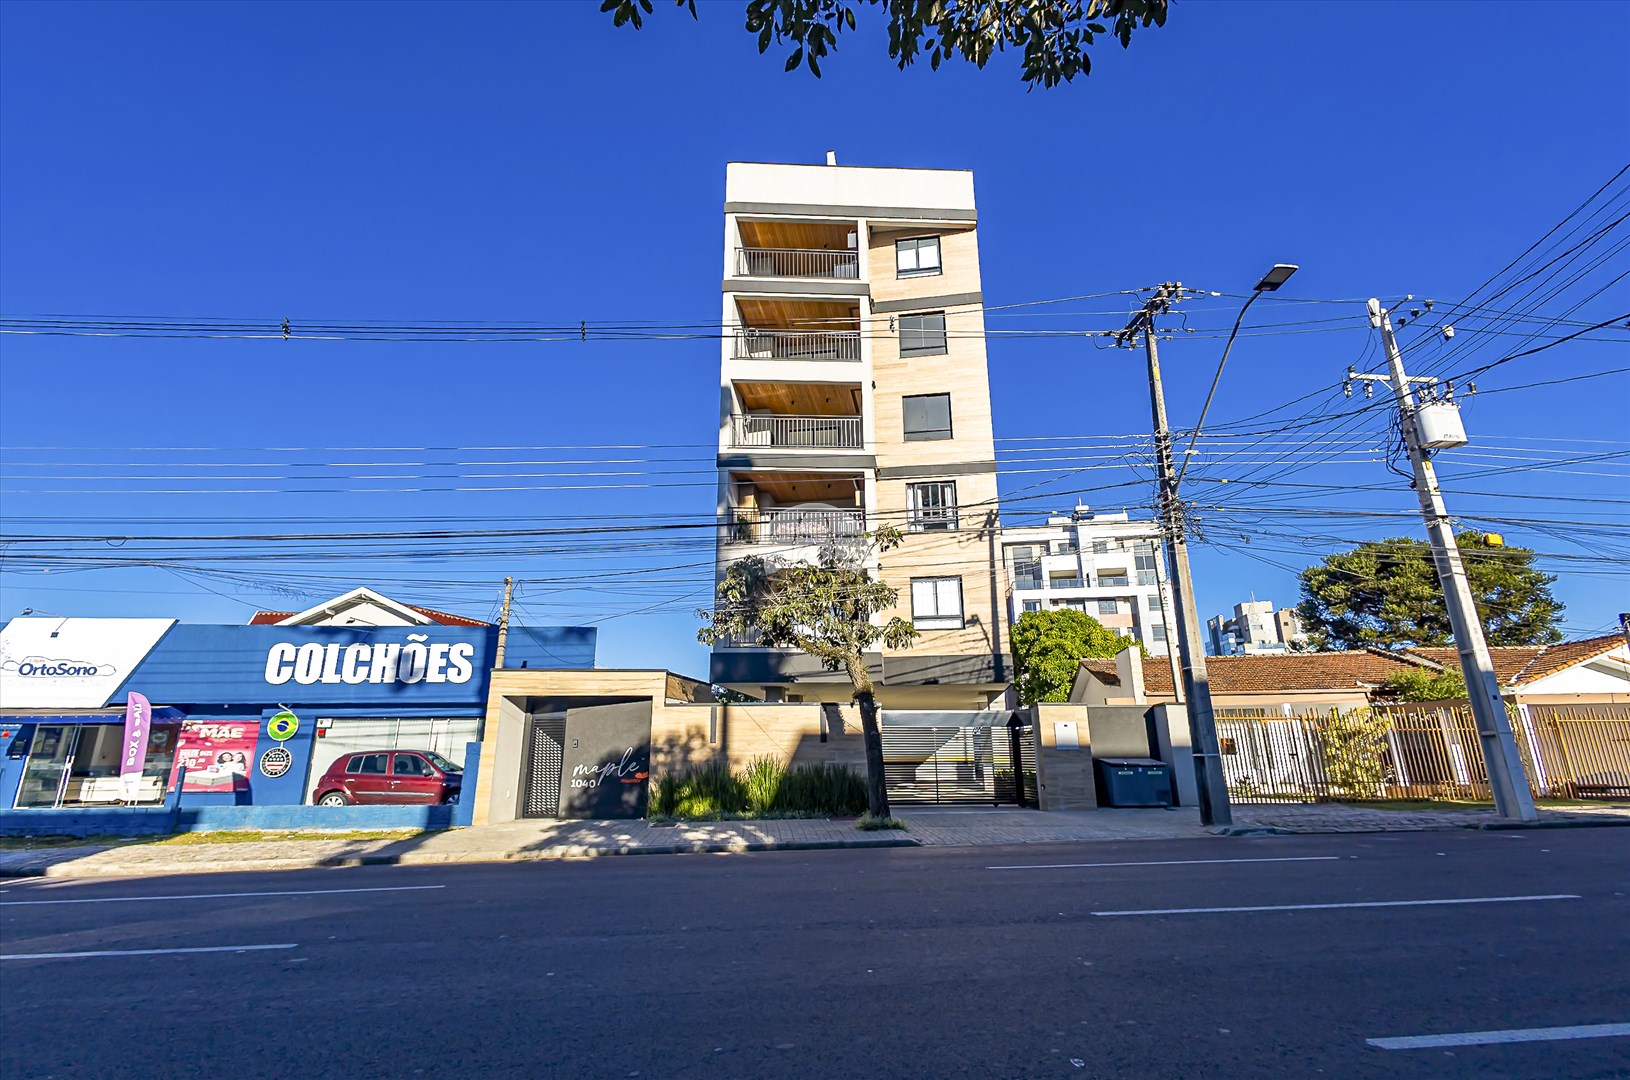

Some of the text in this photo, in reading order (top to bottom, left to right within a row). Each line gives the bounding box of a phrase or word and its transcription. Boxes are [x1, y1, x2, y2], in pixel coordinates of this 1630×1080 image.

[18, 662, 98, 676] OrtoSono
[264, 633, 475, 685] COLCHÕES
[572, 746, 640, 787] maple
[570, 779, 596, 788] 1040
